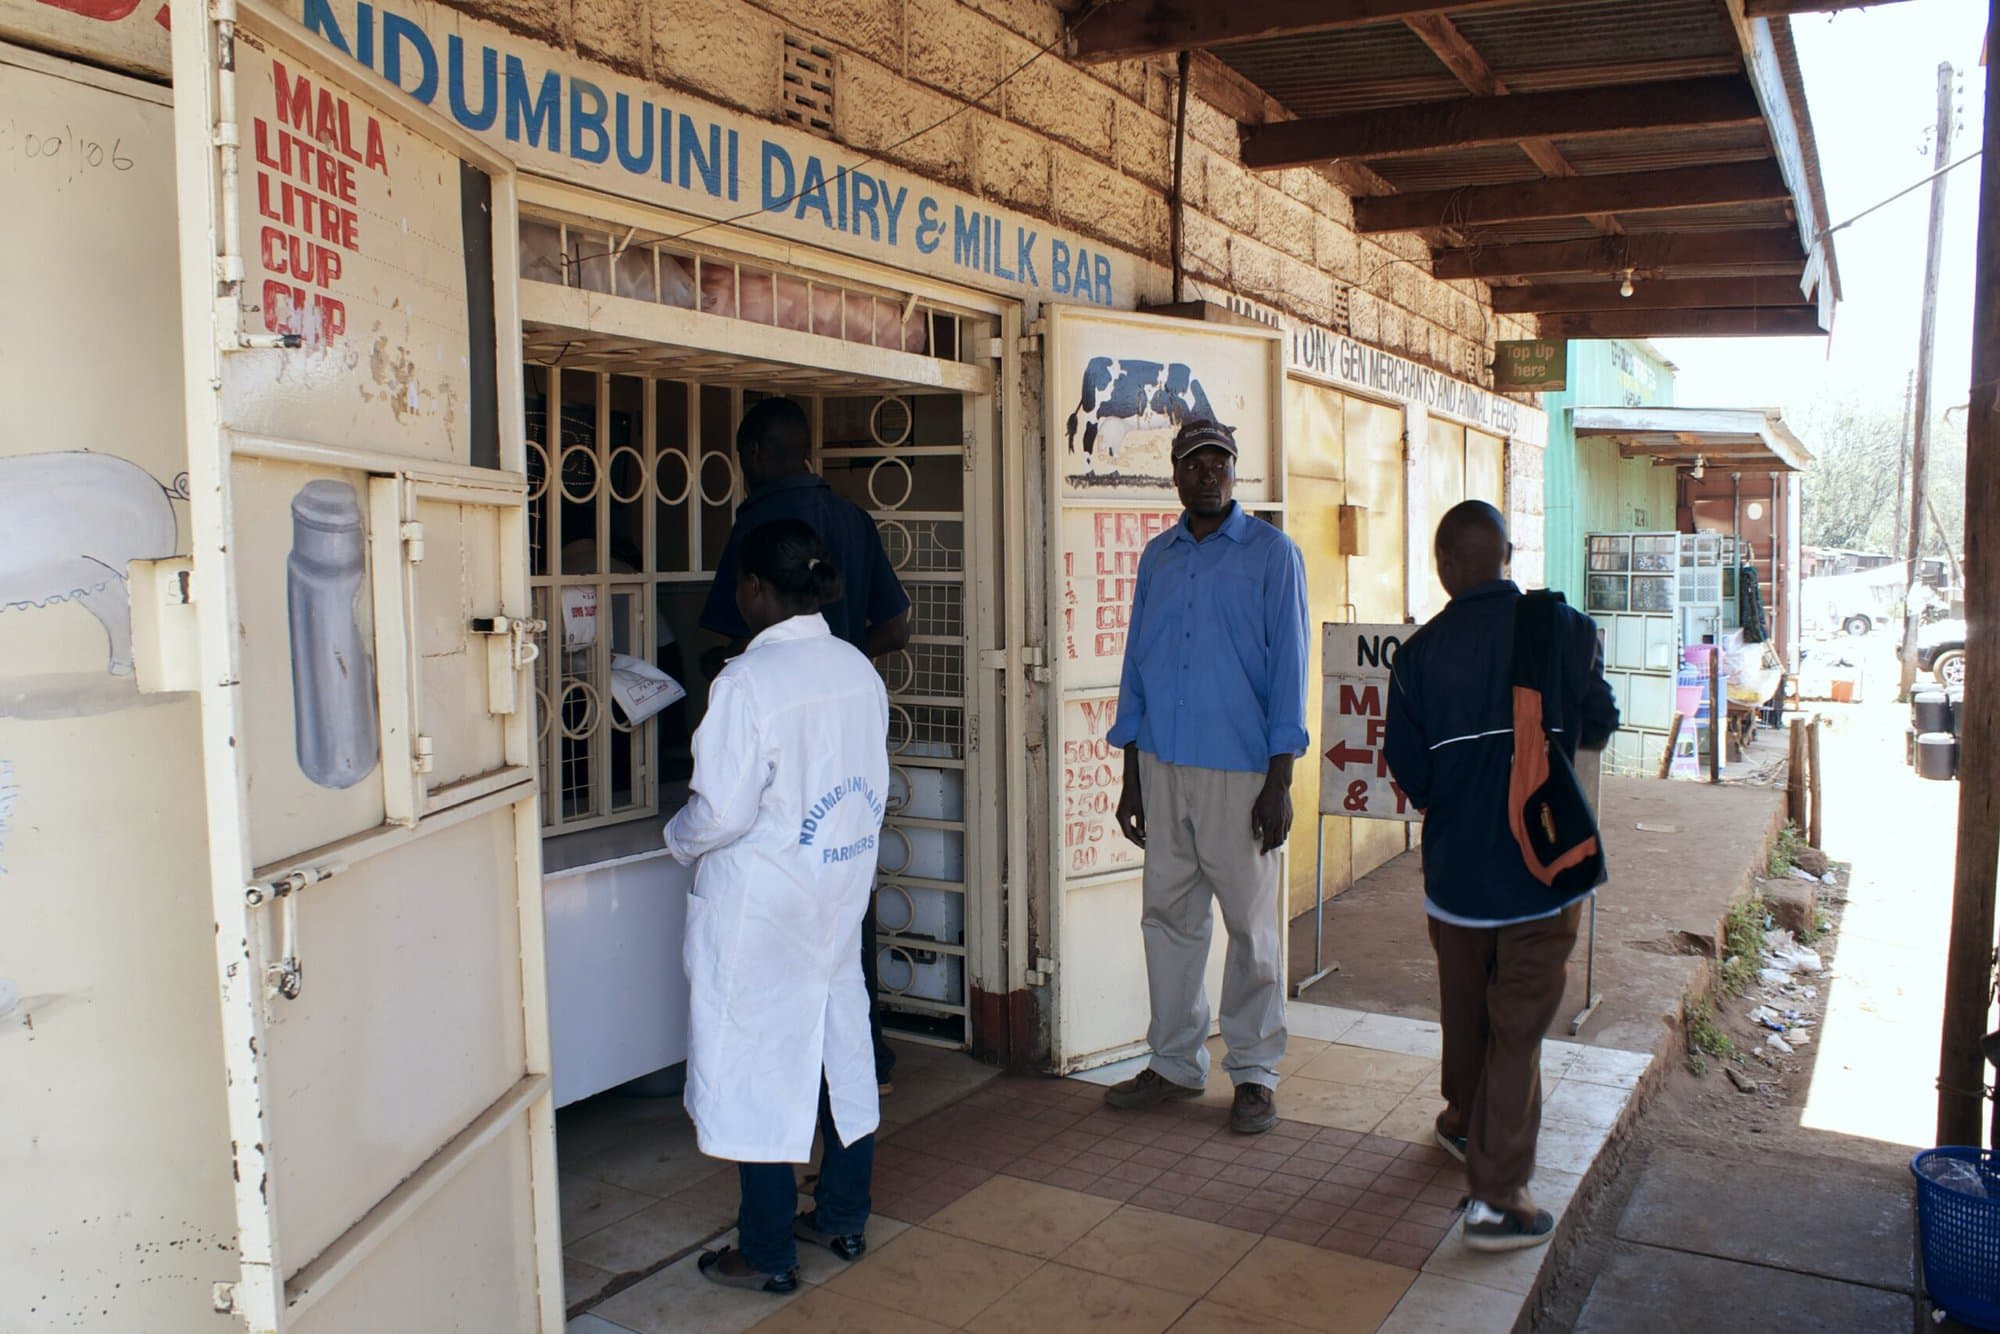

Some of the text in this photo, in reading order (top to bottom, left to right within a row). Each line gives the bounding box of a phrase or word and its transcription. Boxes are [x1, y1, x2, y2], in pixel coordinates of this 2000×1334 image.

[273, 59, 388, 176] MALA
[254, 117, 357, 206] LITRE
[257, 171, 359, 252] LITRE
[762, 140, 908, 246] DAIRY
[916, 196, 946, 254] &
[954, 205, 1039, 287] MILK
[1052, 238, 1113, 305] BAR
[261, 226, 342, 289] CUP
[263, 279, 346, 347] CUP
[1505, 342, 1555, 361] Top Up
[1340, 339, 1366, 385] GEN
[1370, 350, 1436, 405] MERCHANTS
[1438, 376, 1456, 413] AND
[1457, 384, 1488, 423] ANIMAL
[1491, 395, 1518, 434] FEEDS
[1513, 362, 1547, 377] here
